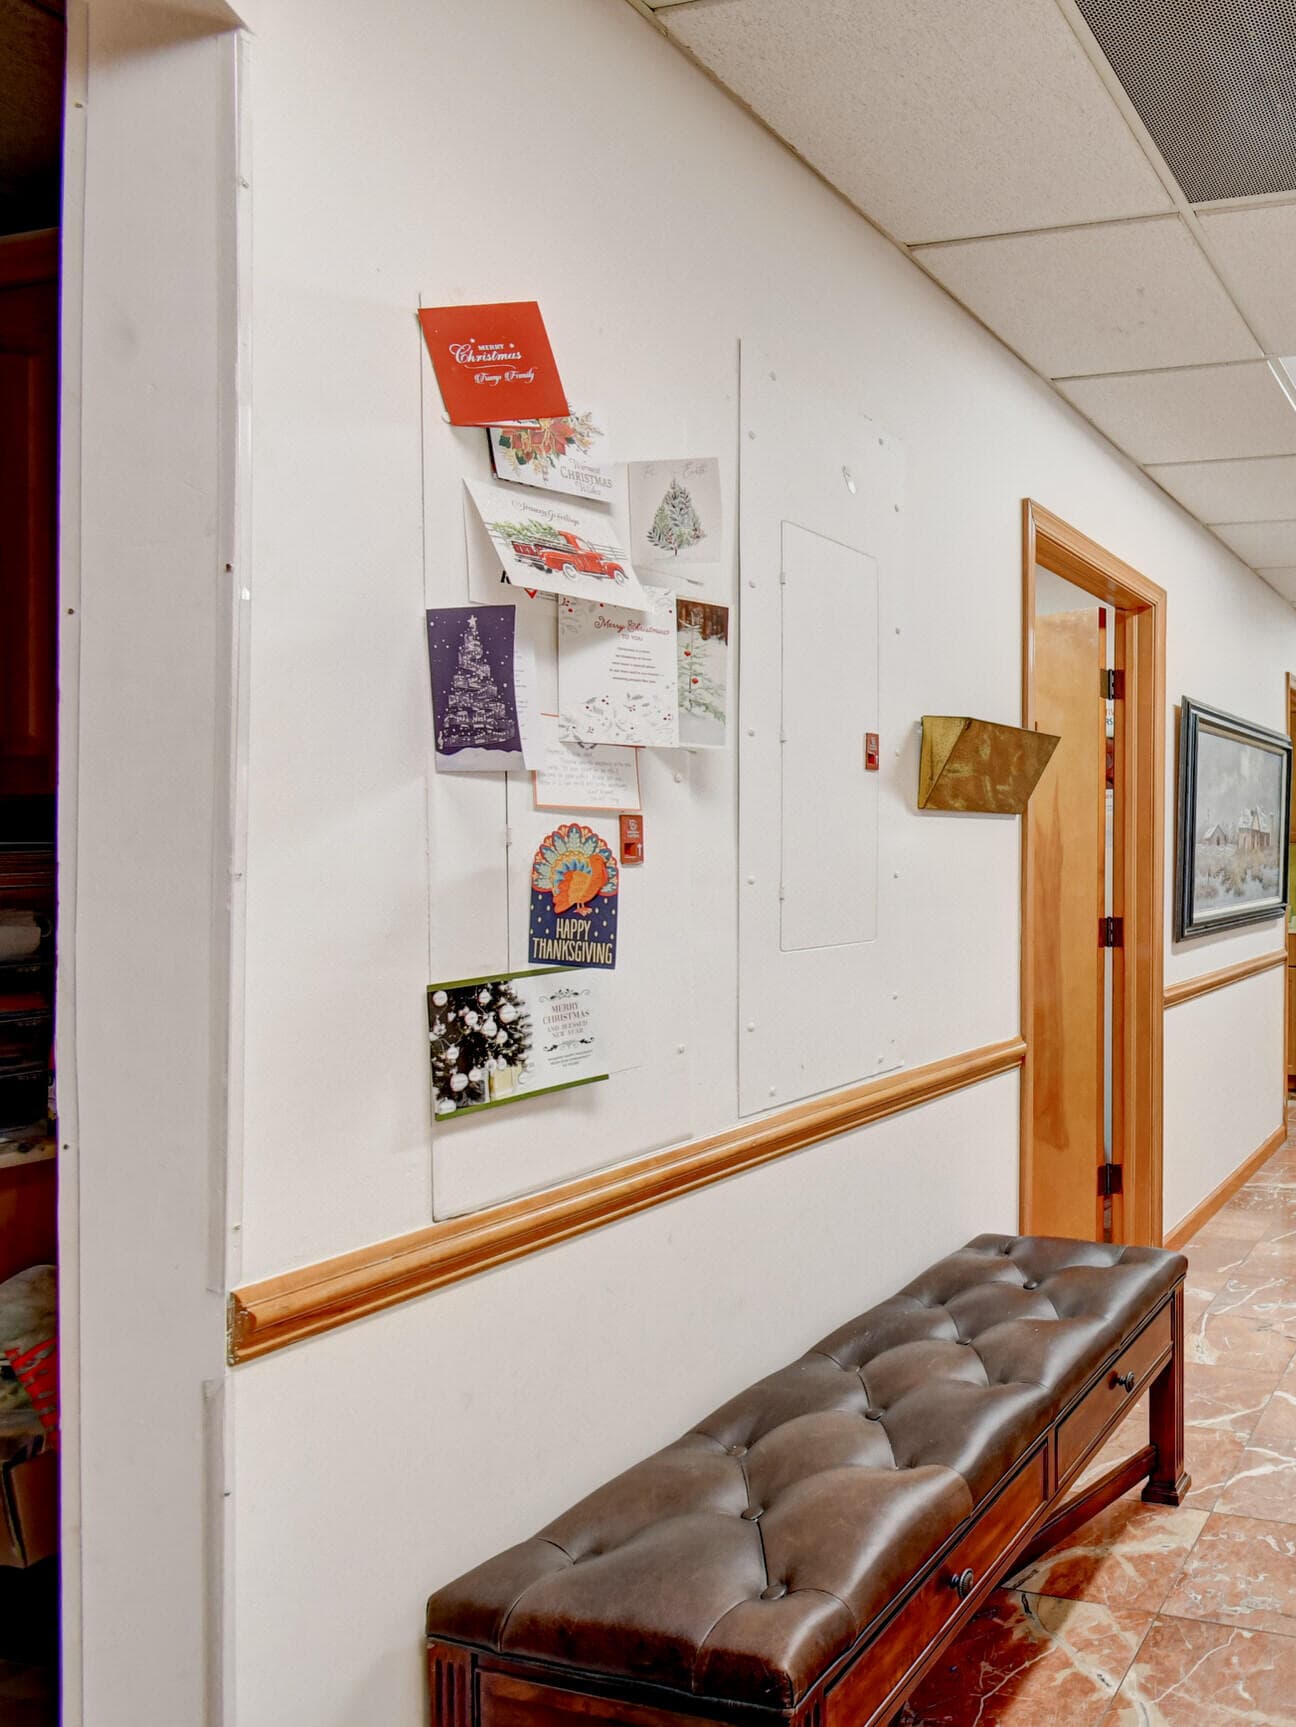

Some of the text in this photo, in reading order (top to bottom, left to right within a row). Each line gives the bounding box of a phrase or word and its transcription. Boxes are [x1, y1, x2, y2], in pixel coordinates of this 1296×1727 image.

[449, 343, 521, 363] Christmas
[560, 466, 613, 488] CHRISTMAS
[594, 615, 626, 633] Merry
[556, 918, 591, 940] HAPPY
[532, 937, 613, 964] THANKSGIVING
[543, 1010, 590, 1024] CHRISTMAS
[551, 1002, 578, 1012] MERRY
